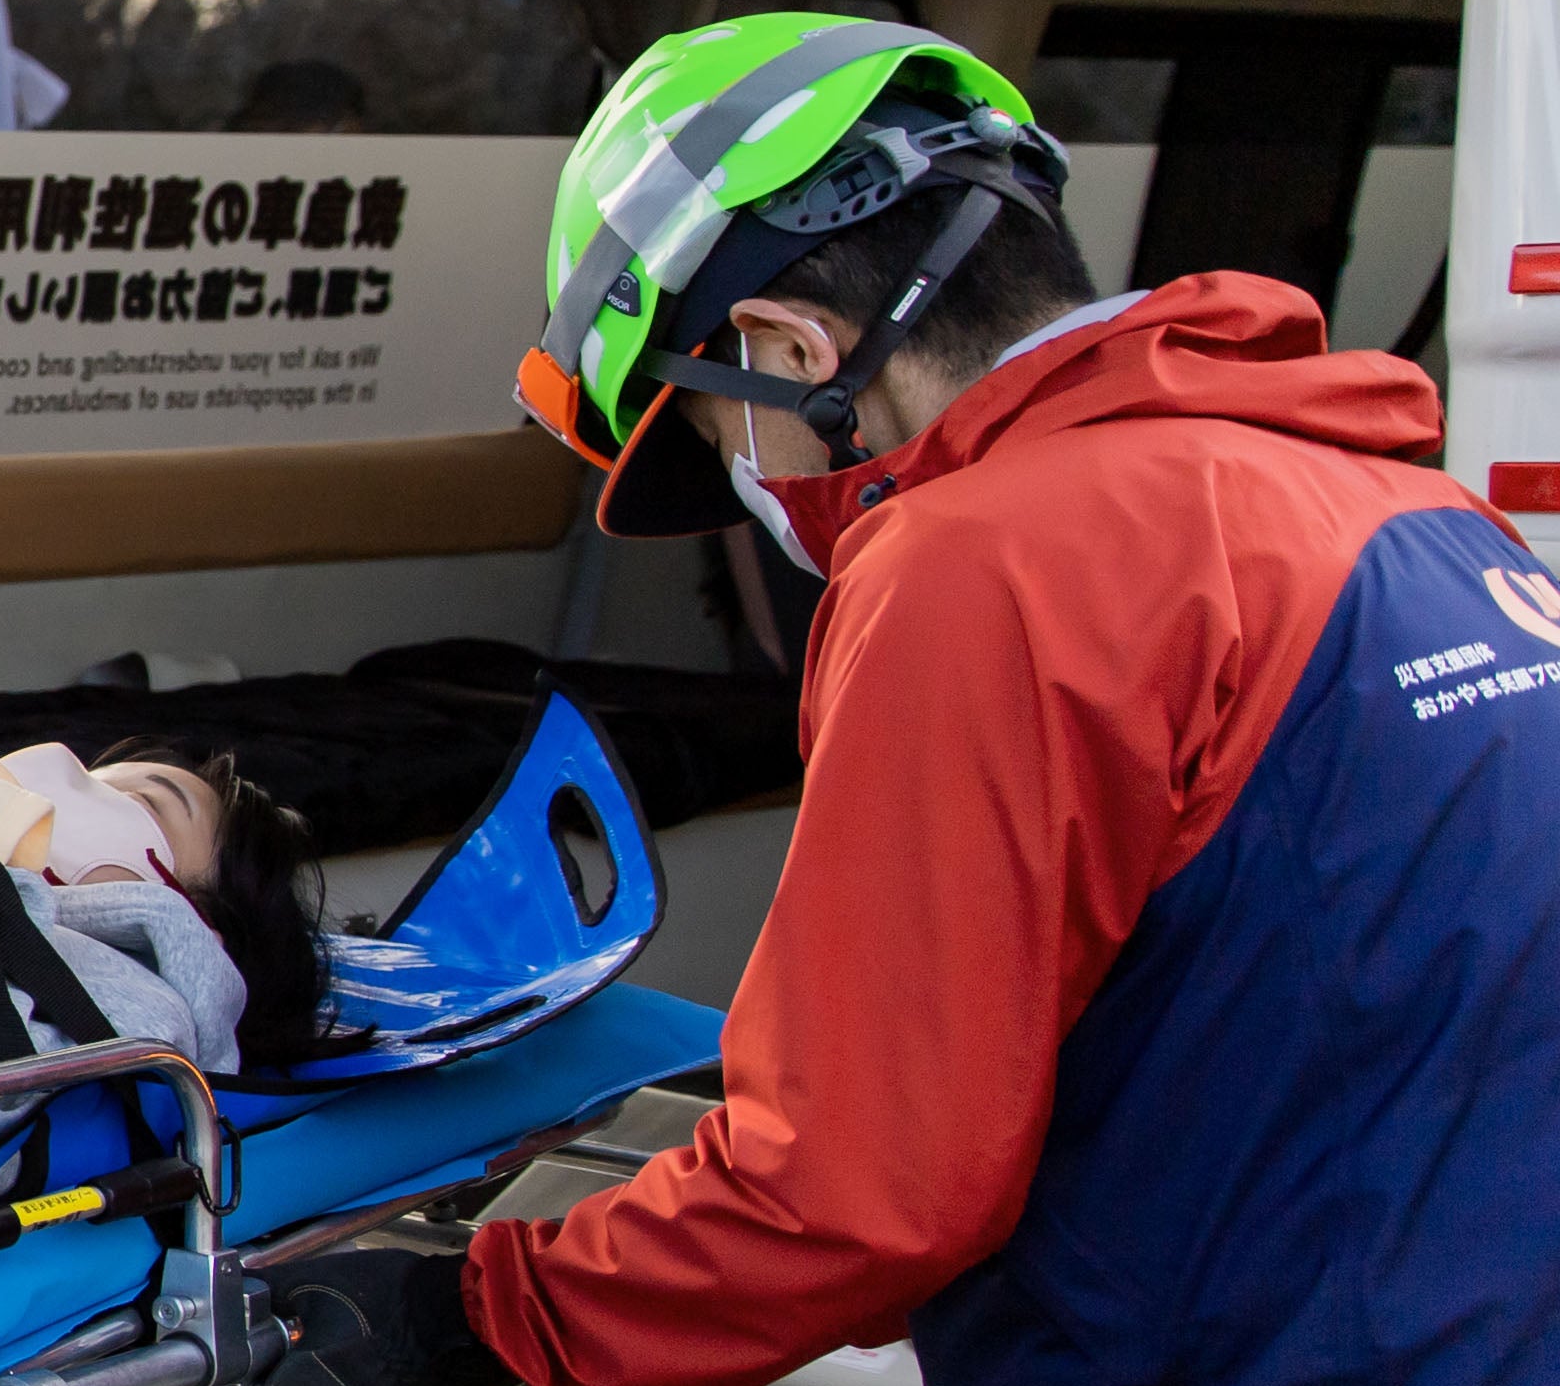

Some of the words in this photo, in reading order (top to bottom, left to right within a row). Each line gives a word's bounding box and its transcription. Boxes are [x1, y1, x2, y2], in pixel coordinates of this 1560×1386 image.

[607, 292, 630, 312] VISOR
[1394, 642, 1496, 690] 災害支援団体
[1412, 661, 1560, 721] おかやま笑顔プロ
